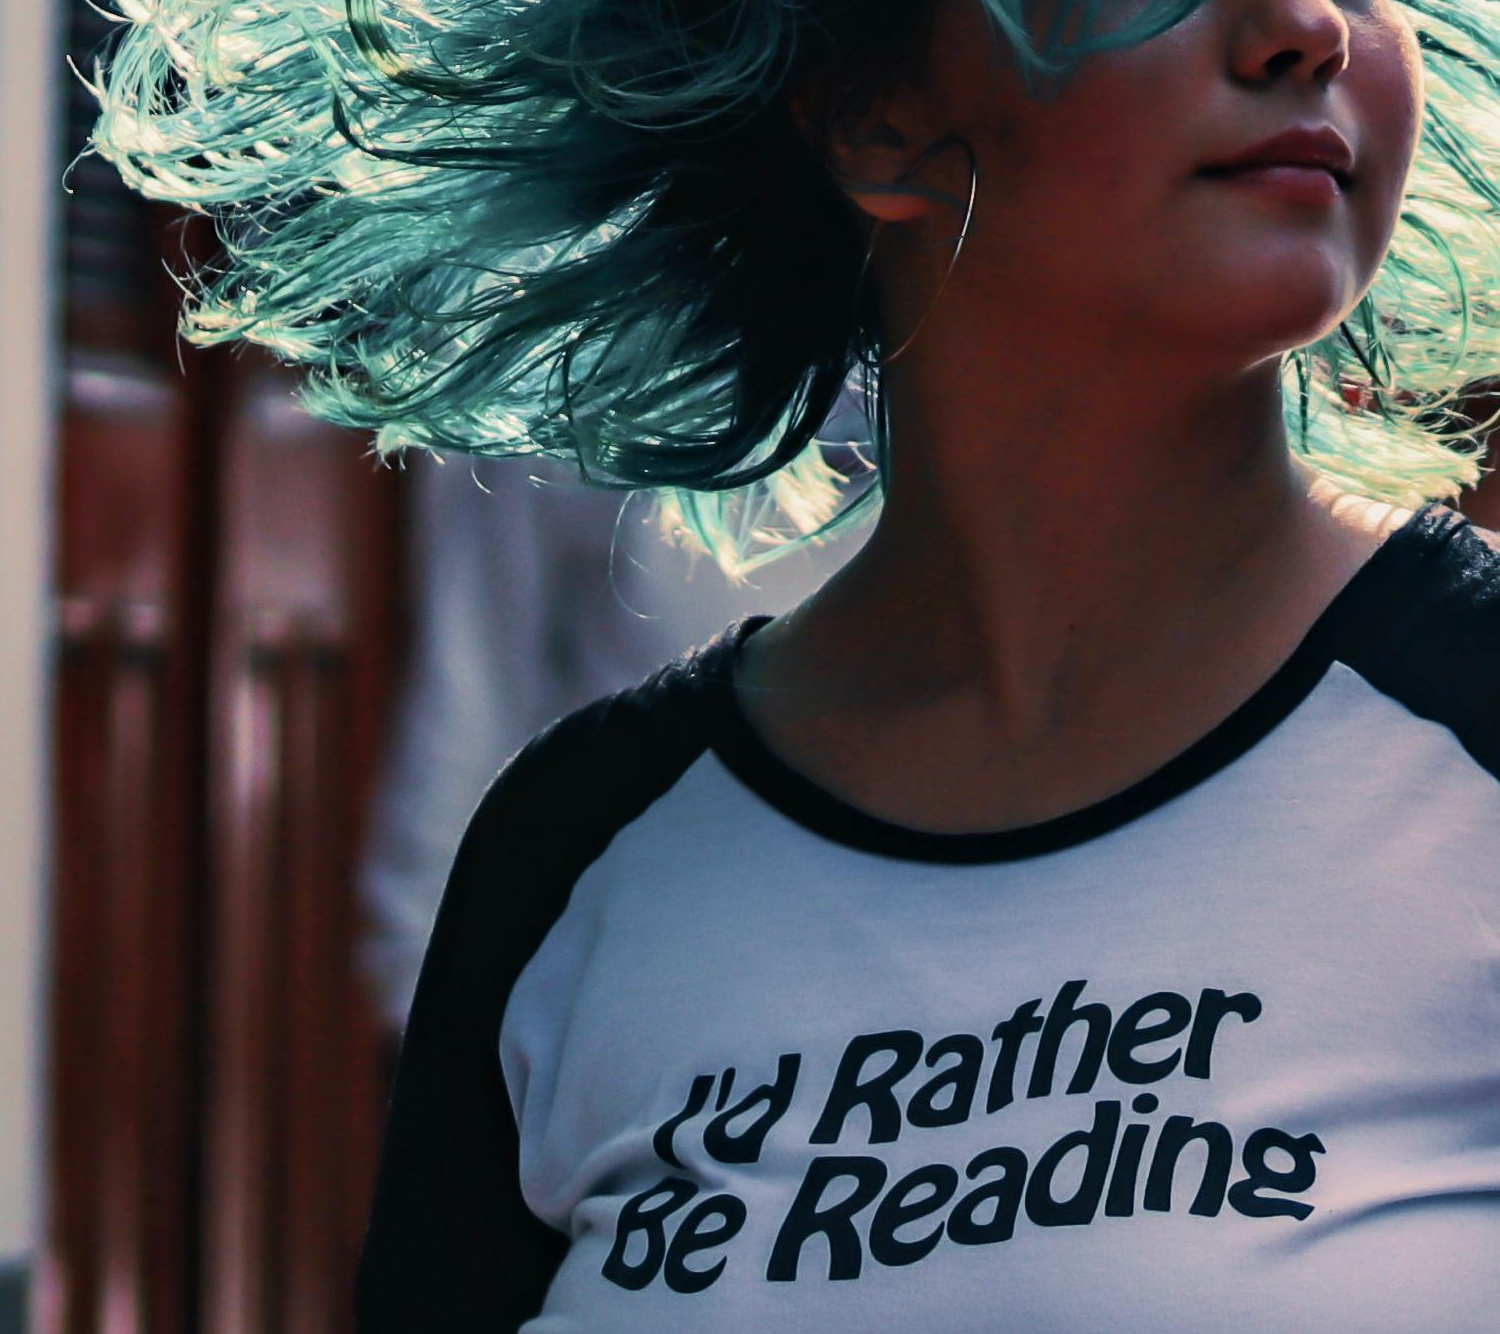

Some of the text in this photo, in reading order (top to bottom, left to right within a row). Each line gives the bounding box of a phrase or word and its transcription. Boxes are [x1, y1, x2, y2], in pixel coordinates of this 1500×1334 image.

[652, 979, 1263, 1171] I'd Rather
[601, 1093, 1327, 1294] Be Reading
